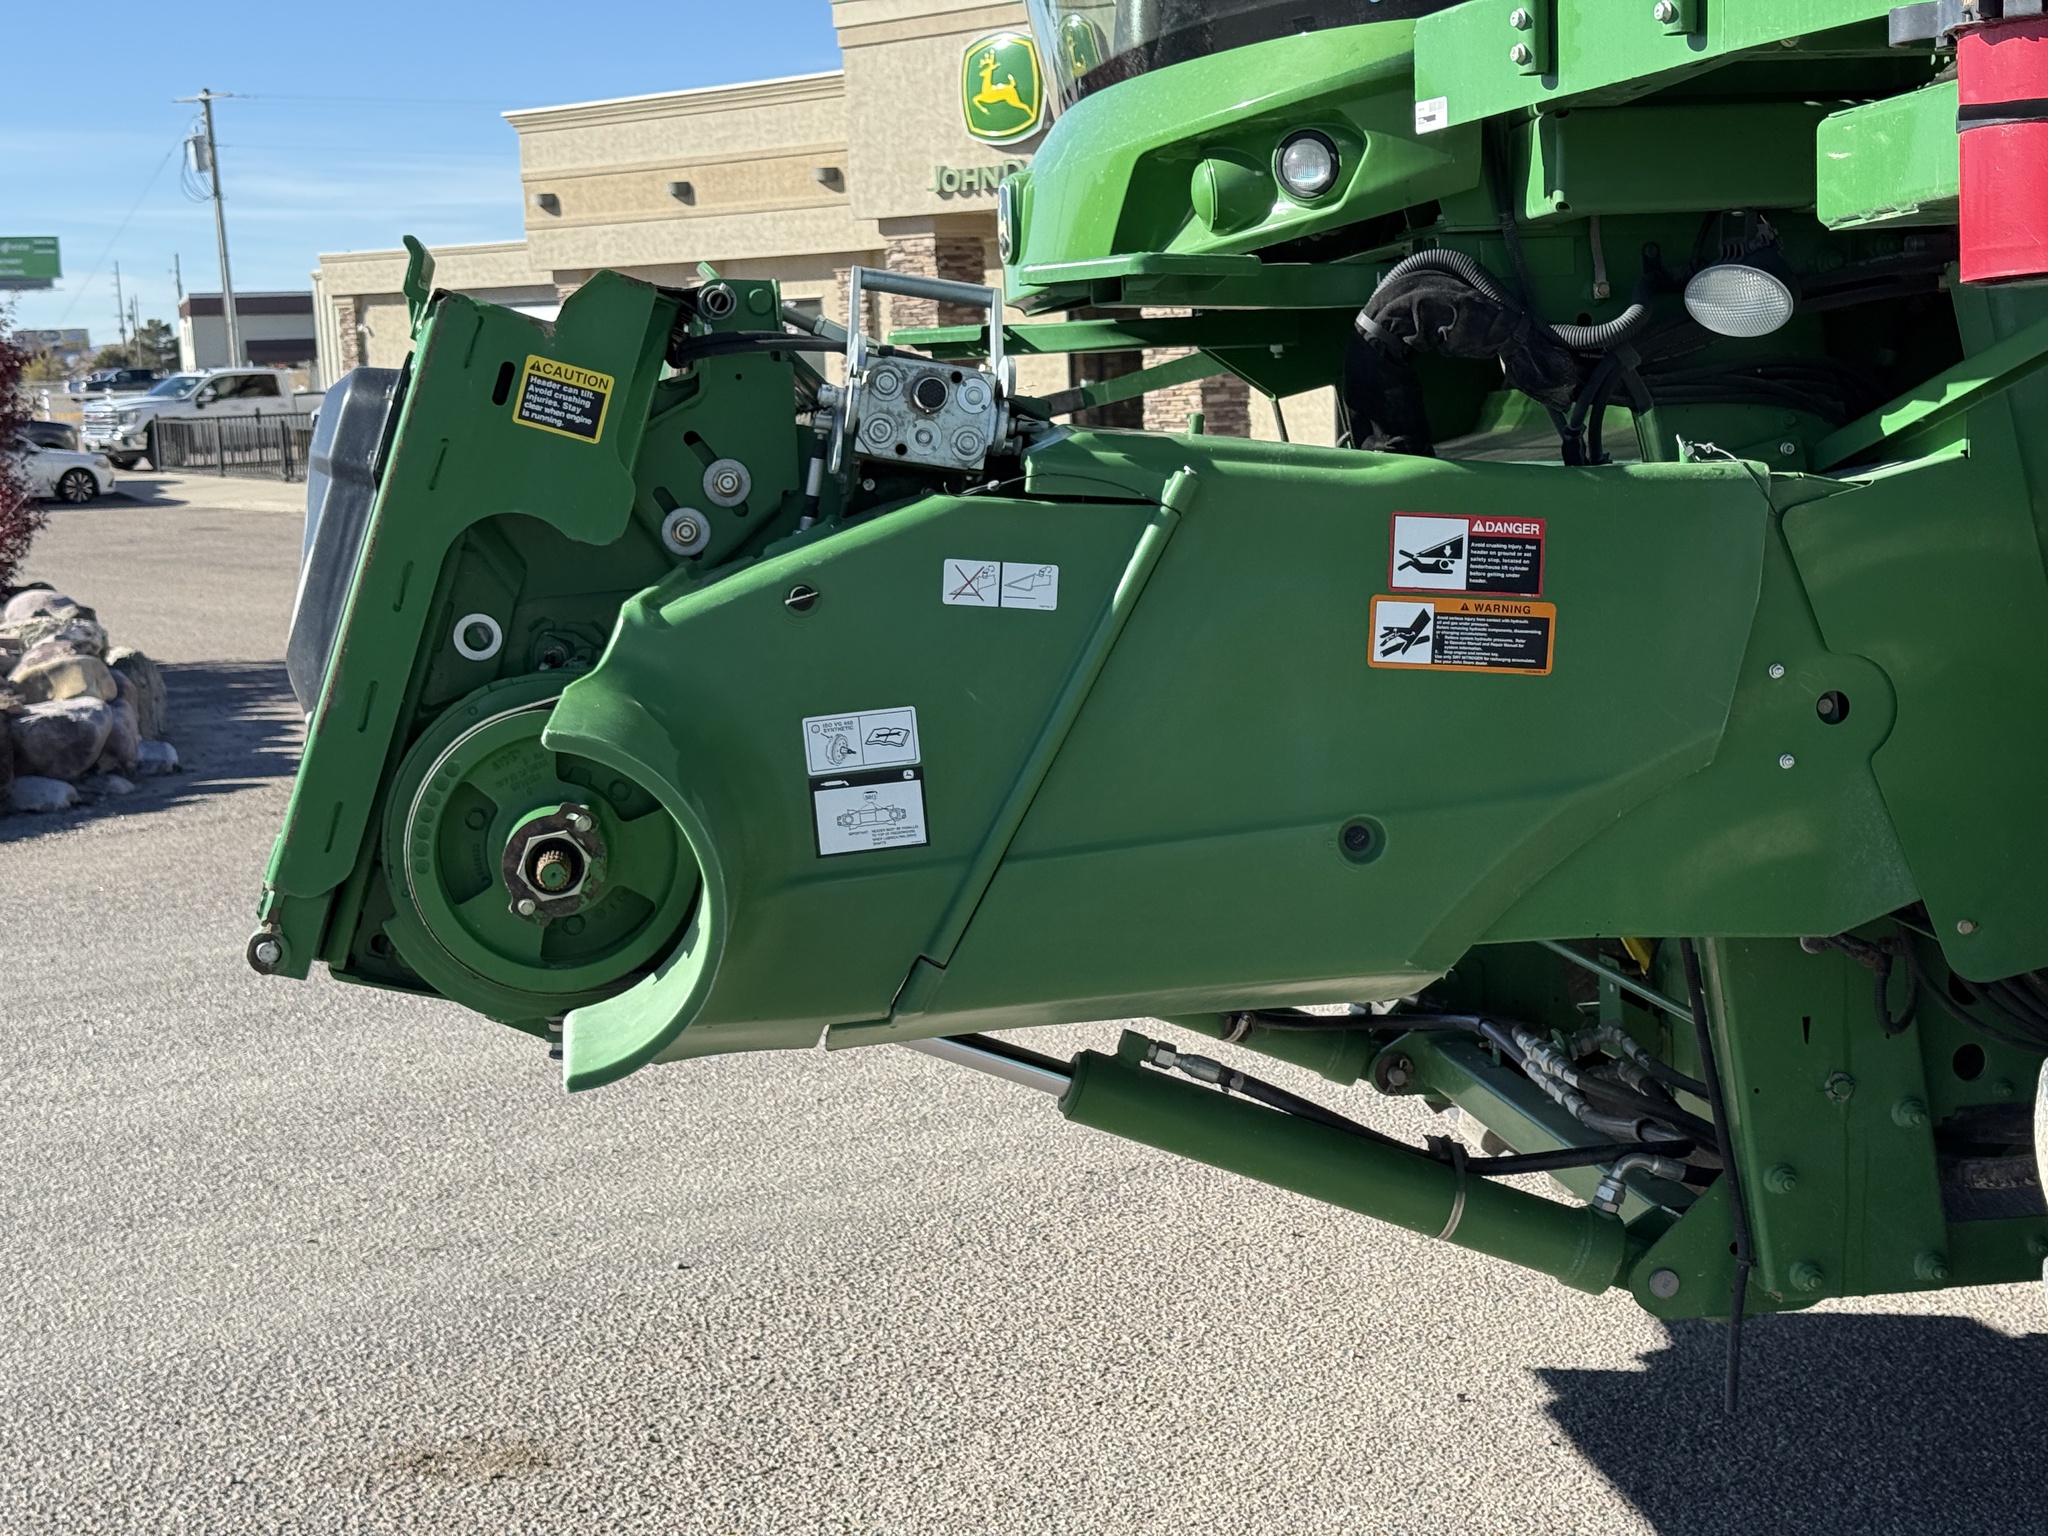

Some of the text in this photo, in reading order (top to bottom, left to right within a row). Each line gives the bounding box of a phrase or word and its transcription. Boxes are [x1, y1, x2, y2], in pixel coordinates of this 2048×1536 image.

[927, 165, 1000, 193] JOHN
[530, 376, 595, 399] Header can tilt.
[543, 363, 609, 390] CAUTION
[526, 393, 581, 414] injuries. Stay
[528, 385, 591, 408] Avoid crushing
[524, 402, 592, 425] clear when engine
[531, 413, 564, 427] running.
[1486, 522, 1540, 534] DANGER
[1474, 603, 1531, 614] WARNING
